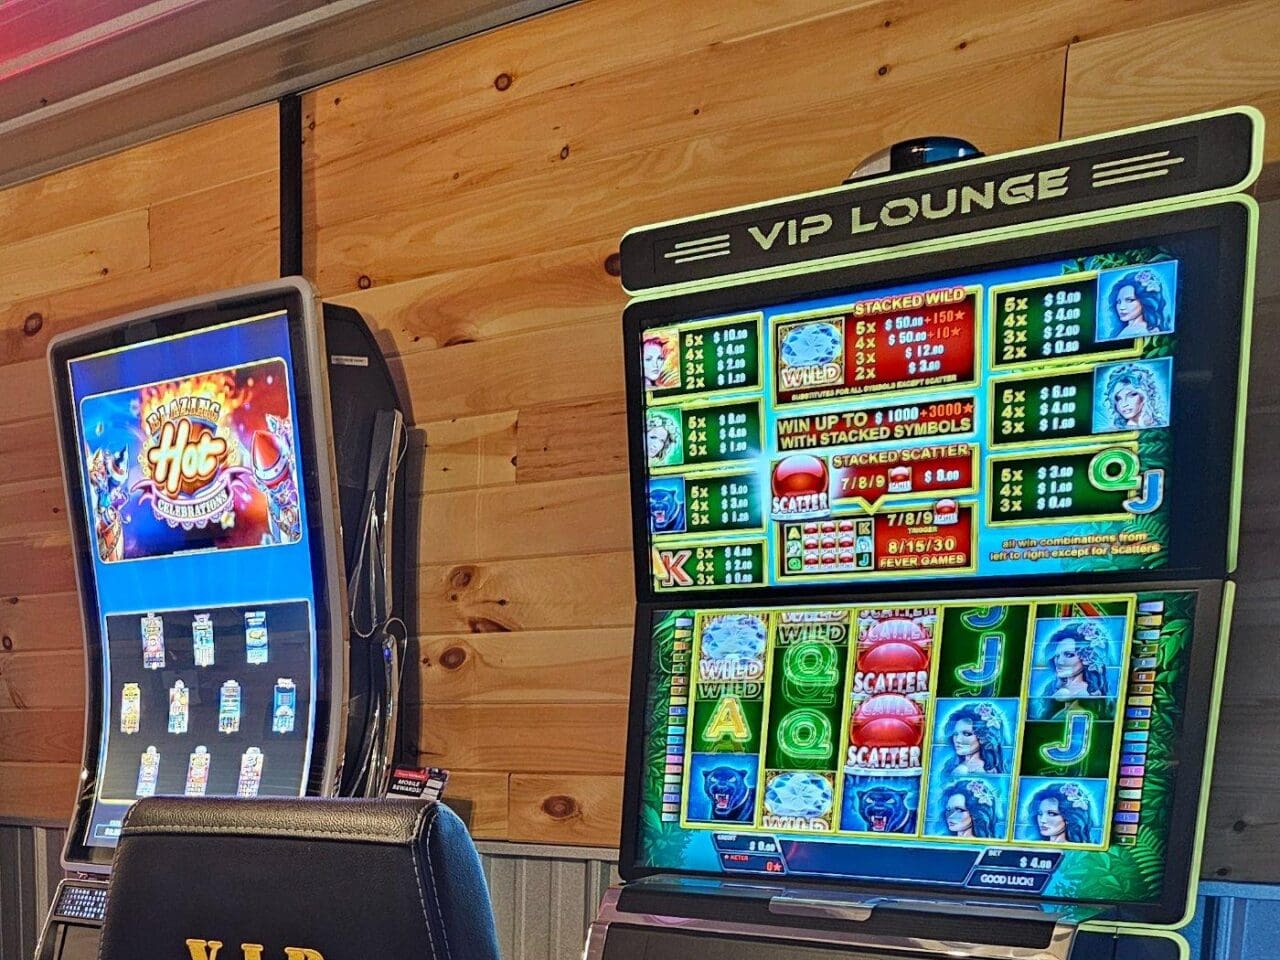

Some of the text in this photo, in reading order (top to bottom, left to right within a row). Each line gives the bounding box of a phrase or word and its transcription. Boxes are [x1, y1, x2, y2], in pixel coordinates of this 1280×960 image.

[747, 166, 1072, 251] VIP LOUNGE
[854, 288, 966, 316] STACKED WILD
[1004, 297, 1028, 312] 5x
[855, 321, 876, 335] 5x
[1003, 313, 1028, 328] 4x
[685, 334, 703, 347] 5x
[855, 337, 876, 350] 4x
[1003, 330, 1027, 345] 3x
[685, 348, 704, 360] 4x
[856, 352, 876, 365] 3x
[1003, 346, 1027, 360] 2x
[685, 362, 704, 375] 3x
[782, 364, 841, 387] WILD
[855, 367, 876, 381] 2x
[686, 376, 705, 389] 2x
[850, 385, 863, 394] ALL
[1002, 389, 1026, 404] 5x
[1001, 406, 1026, 419] 4x
[688, 416, 706, 429] 5x
[778, 412, 868, 435] WIN UP TO
[1001, 420, 1025, 435] 3x
[688, 430, 707, 442] 4x
[780, 418, 971, 450] WITH STACKED SYMBOLS
[148, 418, 227, 494] Hot
[688, 444, 707, 457] 3x
[833, 444, 969, 468] STACKED SCATTER
[1001, 468, 1023, 482] 5x
[1088, 447, 1141, 491] Q
[841, 475, 886, 490] 7/8/9
[690, 485, 709, 498] 5x
[1000, 484, 1023, 497] 4x
[1122, 469, 1165, 514] J
[157, 489, 228, 517] CELEBRATIONS
[690, 499, 709, 511] 4x
[772, 493, 829, 513] SCATTER
[1000, 499, 1022, 512] 3x
[691, 512, 710, 525] 3x
[887, 512, 933, 526] 7/8/9
[888, 538, 955, 553] 8/15/30
[1018, 539, 1037, 548] win
[1040, 534, 1116, 547] combinations
[1119, 532, 1148, 542] from
[696, 547, 714, 559] 5x
[1009, 551, 1020, 560] to
[1051, 548, 1089, 558] except
[1092, 547, 1109, 555] for
[1110, 543, 1162, 555] Scatters
[660, 549, 694, 587] K
[696, 560, 714, 572] 4x
[880, 554, 965, 568] FEVER GAMES
[697, 573, 714, 585] 3x
[783, 639, 840, 686] Q
[954, 632, 1006, 686] J
[699, 659, 764, 681] WILD
[853, 671, 927, 693] SCATTER
[701, 694, 752, 742] A
[777, 708, 833, 759] Q
[1039, 710, 1094, 766] J
[848, 746, 920, 768] SCATTER
[980, 874, 1006, 885] GOOD
